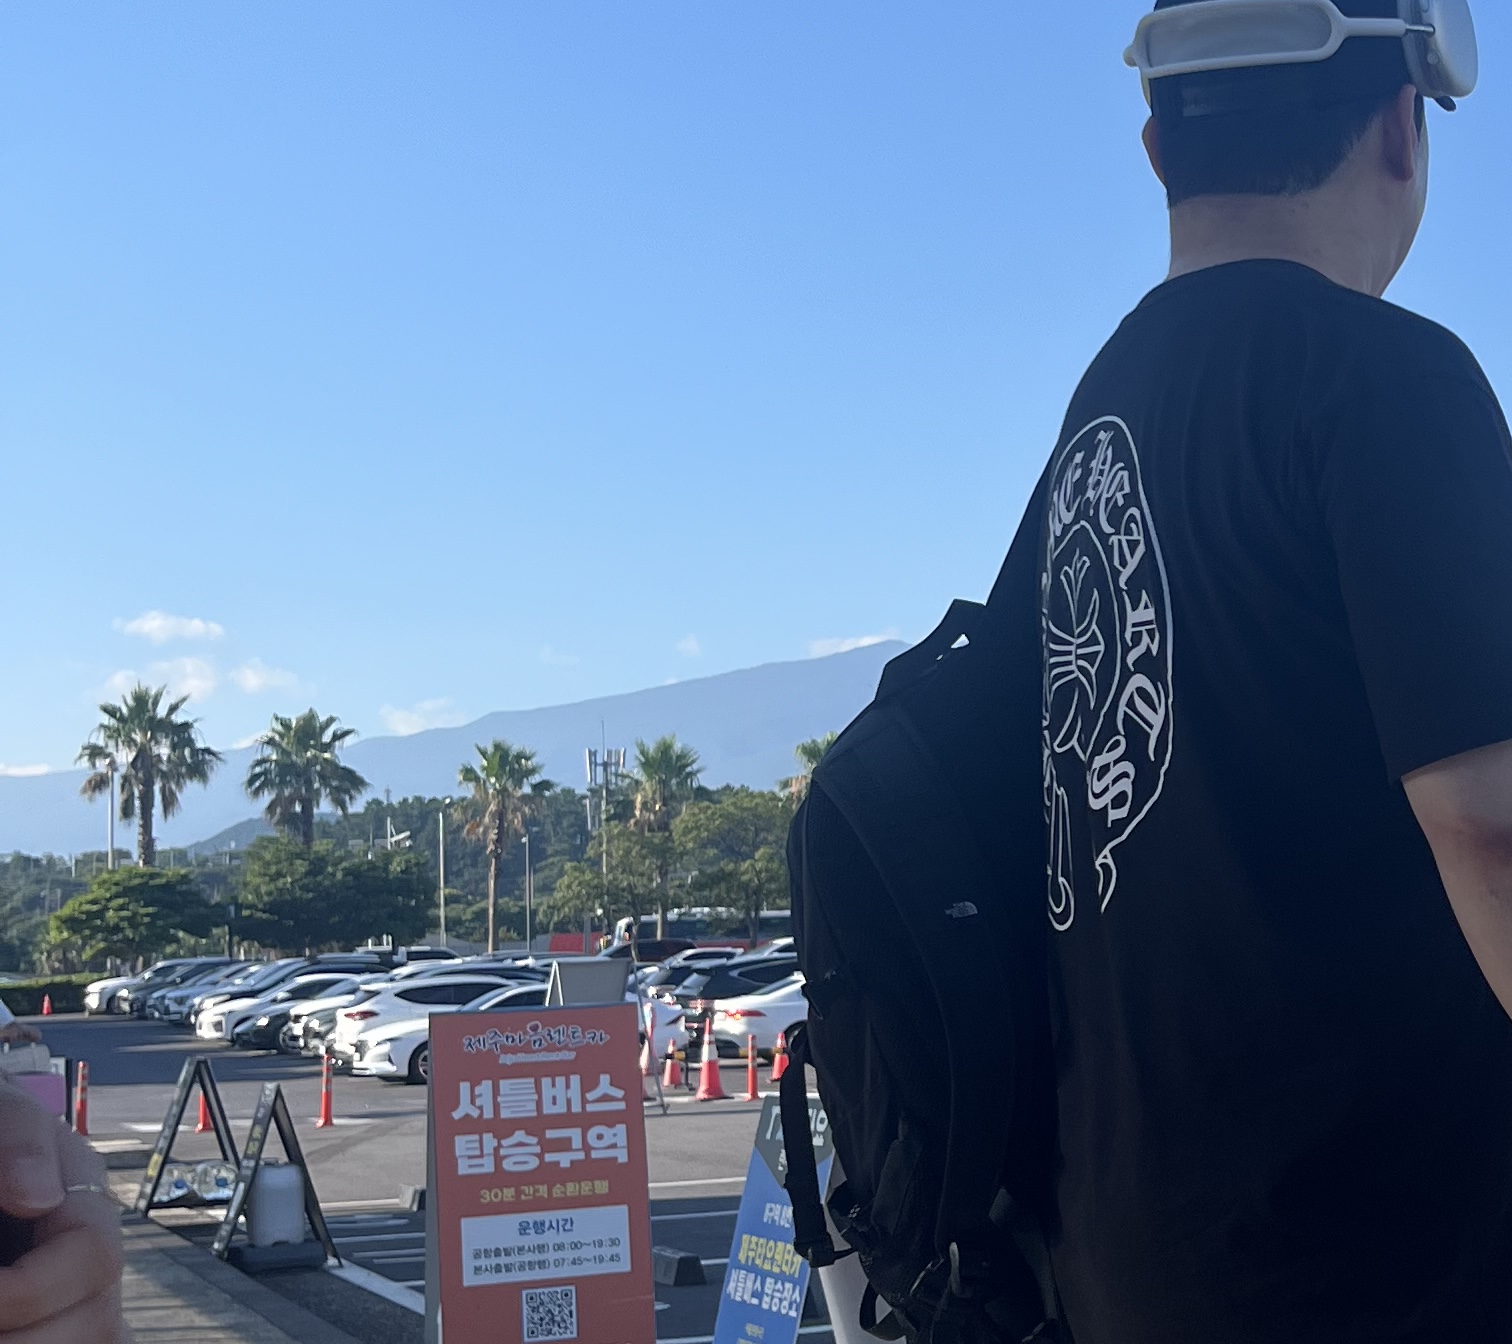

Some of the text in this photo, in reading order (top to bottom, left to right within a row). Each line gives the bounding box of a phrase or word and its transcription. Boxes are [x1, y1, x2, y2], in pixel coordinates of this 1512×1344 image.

[451, 1073, 627, 1121] 셔틀버스
[453, 1123, 629, 1176] 탑승구역
[479, 1179, 610, 1204] 30분 간격 순환운행
[517, 1217, 574, 1237] 운행시간
[472, 1237, 621, 1260] 공항출발(본사행) 08:00~19:30
[473, 1253, 621, 1276] 본사출발(공항행) 07:45~19:45
